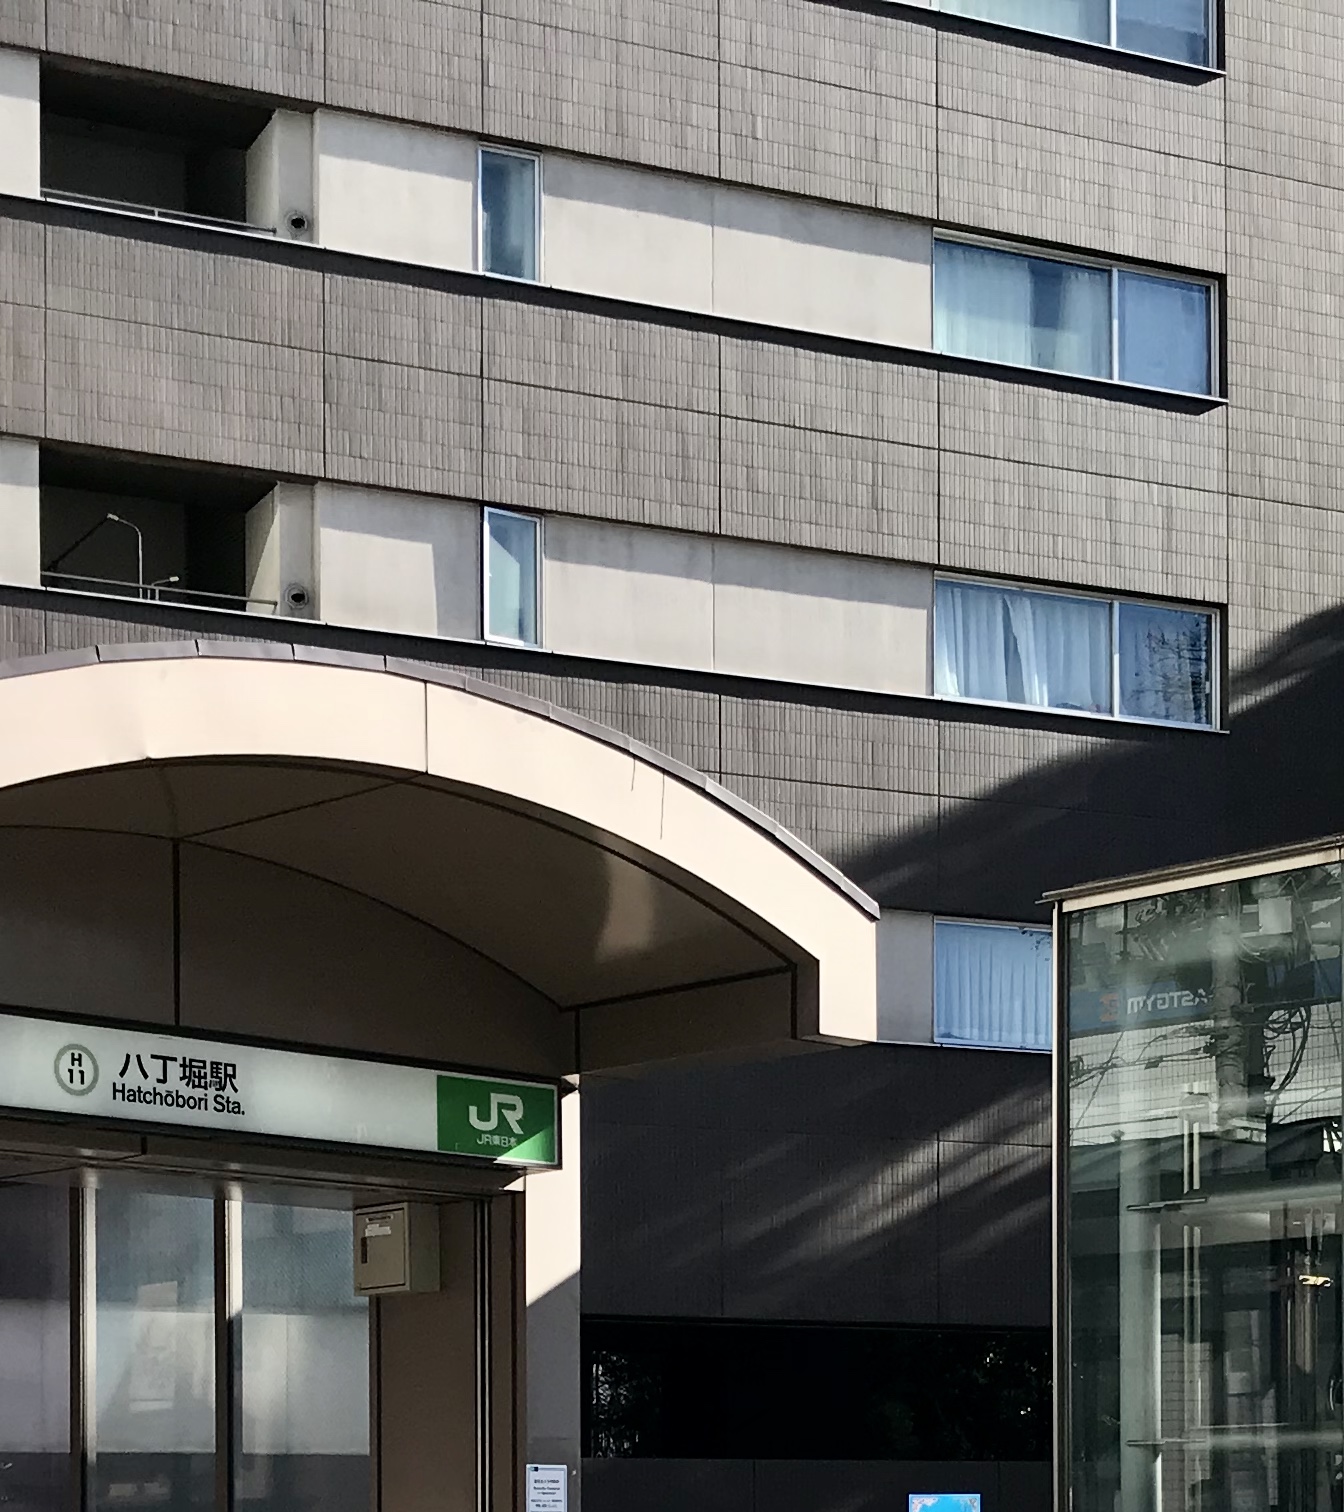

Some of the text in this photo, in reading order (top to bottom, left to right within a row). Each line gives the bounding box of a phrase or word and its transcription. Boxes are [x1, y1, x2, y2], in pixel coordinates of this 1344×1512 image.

[70, 1052, 83, 1068] H
[67, 1069, 86, 1086] 11
[118, 1052, 239, 1094] 八丁堀駅
[112, 1082, 246, 1116] Hatchōbori Sta.
[468, 1091, 524, 1135] JR
[476, 1133, 518, 1148] JR東日本
